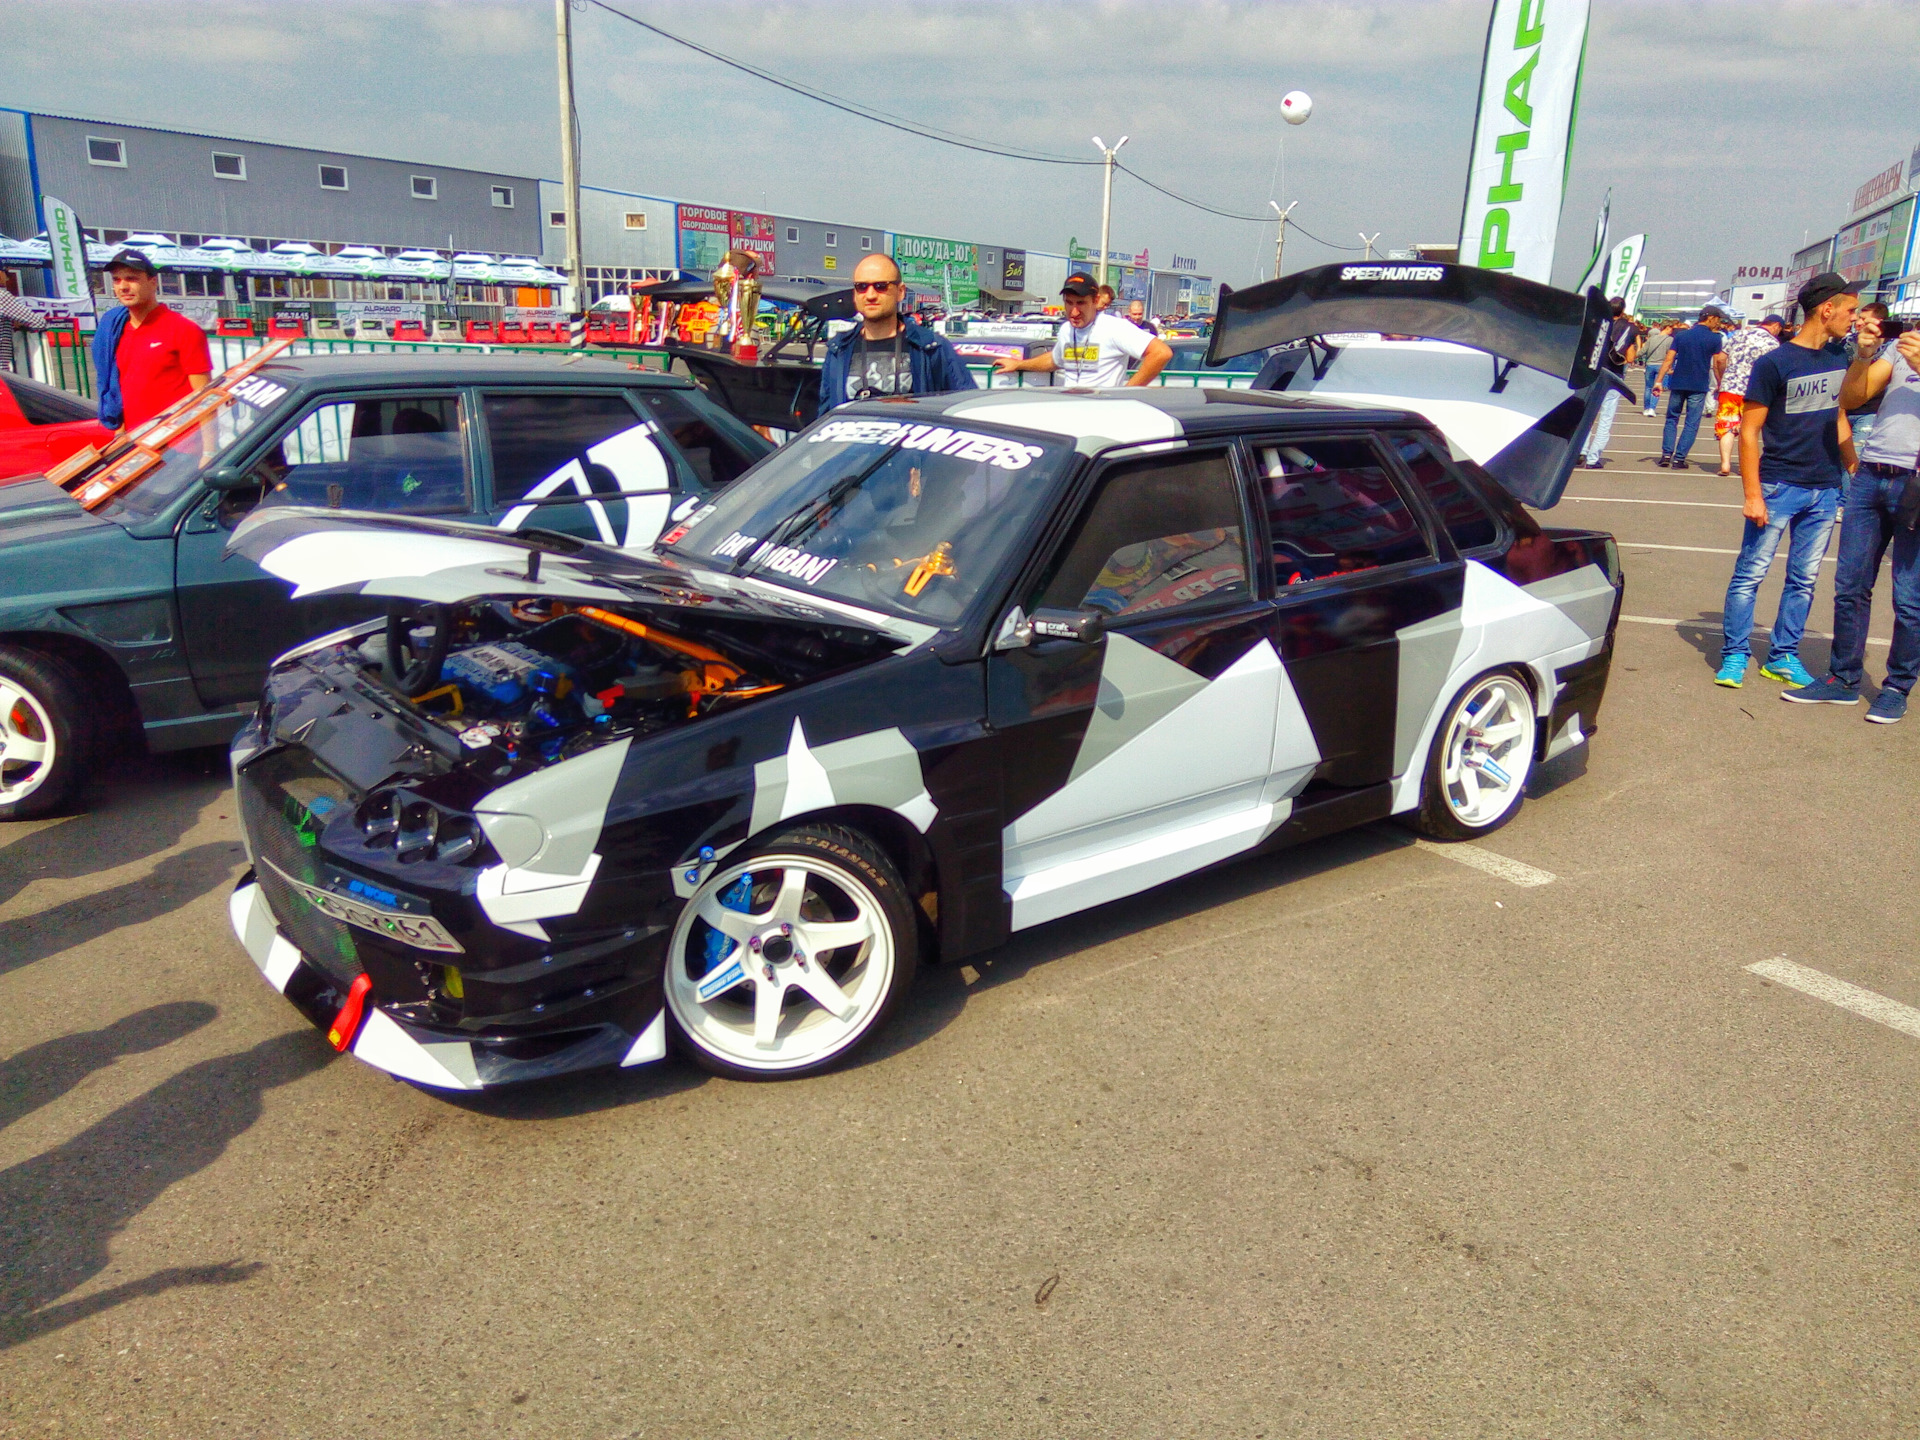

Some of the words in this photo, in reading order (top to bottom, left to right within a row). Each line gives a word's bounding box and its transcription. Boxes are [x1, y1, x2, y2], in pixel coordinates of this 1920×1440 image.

[681, 206, 728, 221] ТОРГОВОЕ
[682, 220, 729, 232] ОБОРУДОВАНИЕ
[54, 208, 79, 296] ALPHARD
[732, 237, 775, 252] ИГРУШКИ
[904, 239, 971, 264] ПОСУДА-ЮГ
[1340, 266, 1444, 281] SPEEDHUNTERS
[1738, 266, 1790, 280] КОНД
[364, 305, 402, 313] ALPHARD
[227, 374, 289, 408] EAM
[1794, 379, 1829, 398] NIKE
[808, 421, 1044, 470] SPEEDHUNTERS
[1047, 622, 1070, 631] craft
